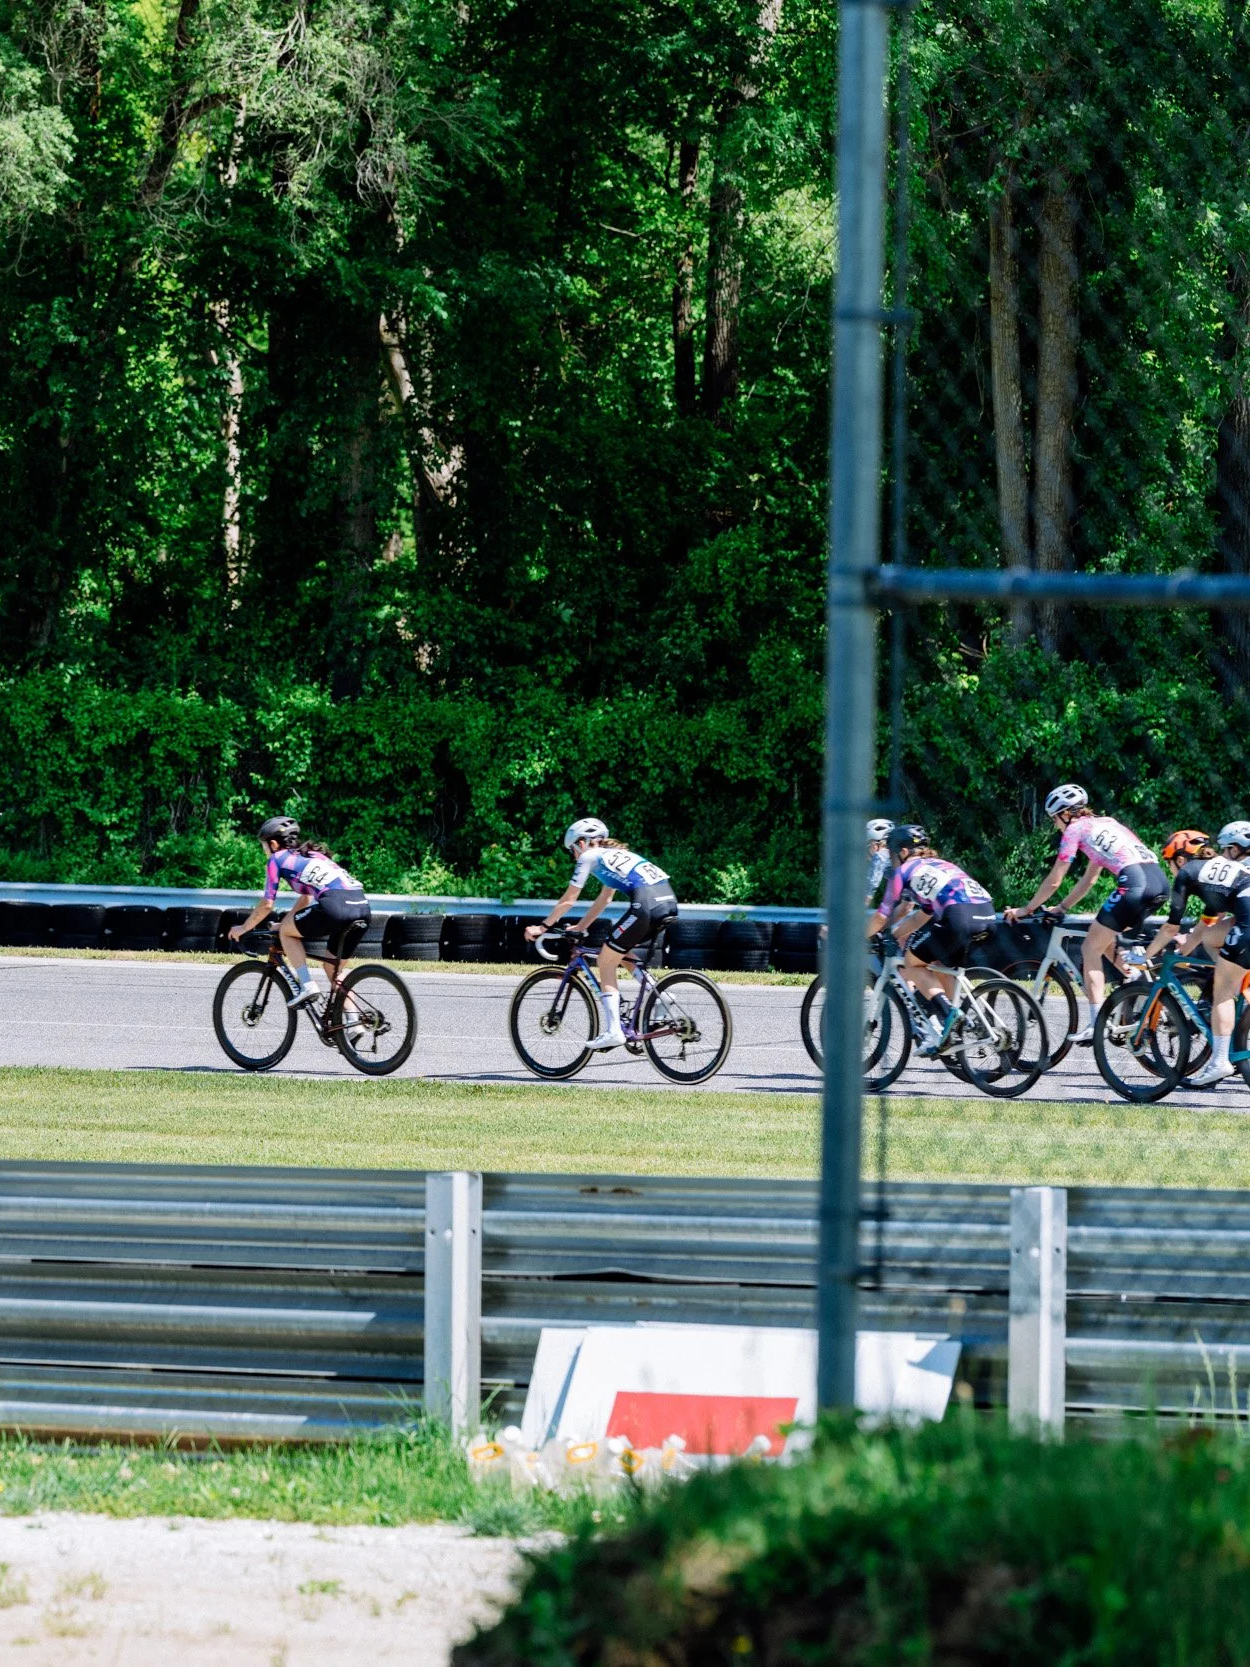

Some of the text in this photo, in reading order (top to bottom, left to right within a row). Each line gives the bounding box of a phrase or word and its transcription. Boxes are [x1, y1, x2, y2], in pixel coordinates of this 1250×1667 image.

[1095, 829, 1118, 852] 63
[608, 851, 631, 872] 52
[1207, 862, 1231, 882] 56
[308, 865, 329, 883] 64
[916, 873, 938, 896] 59
